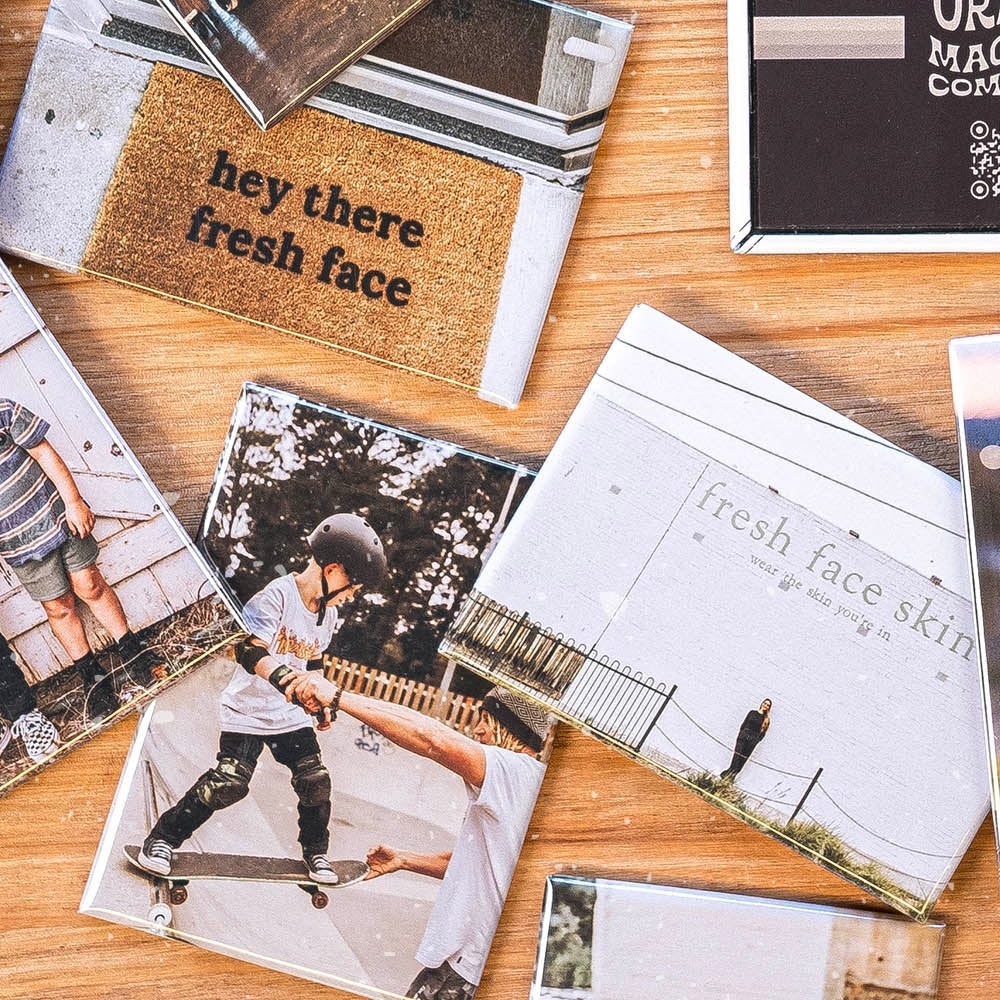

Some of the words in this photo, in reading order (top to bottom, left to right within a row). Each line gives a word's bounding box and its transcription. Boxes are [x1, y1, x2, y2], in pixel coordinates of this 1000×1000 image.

[208, 150, 293, 216] hey
[303, 184, 424, 248] there
[185, 205, 304, 275] fresh
[316, 246, 412, 307] face
[696, 481, 792, 557] fresh
[805, 543, 883, 606] face
[893, 597, 977, 662] skin
[749, 554, 779, 577] wear
[782, 571, 803, 590] the
[806, 587, 832, 608] skin
[833, 605, 874, 632] you're
[877, 625, 892, 642] in
